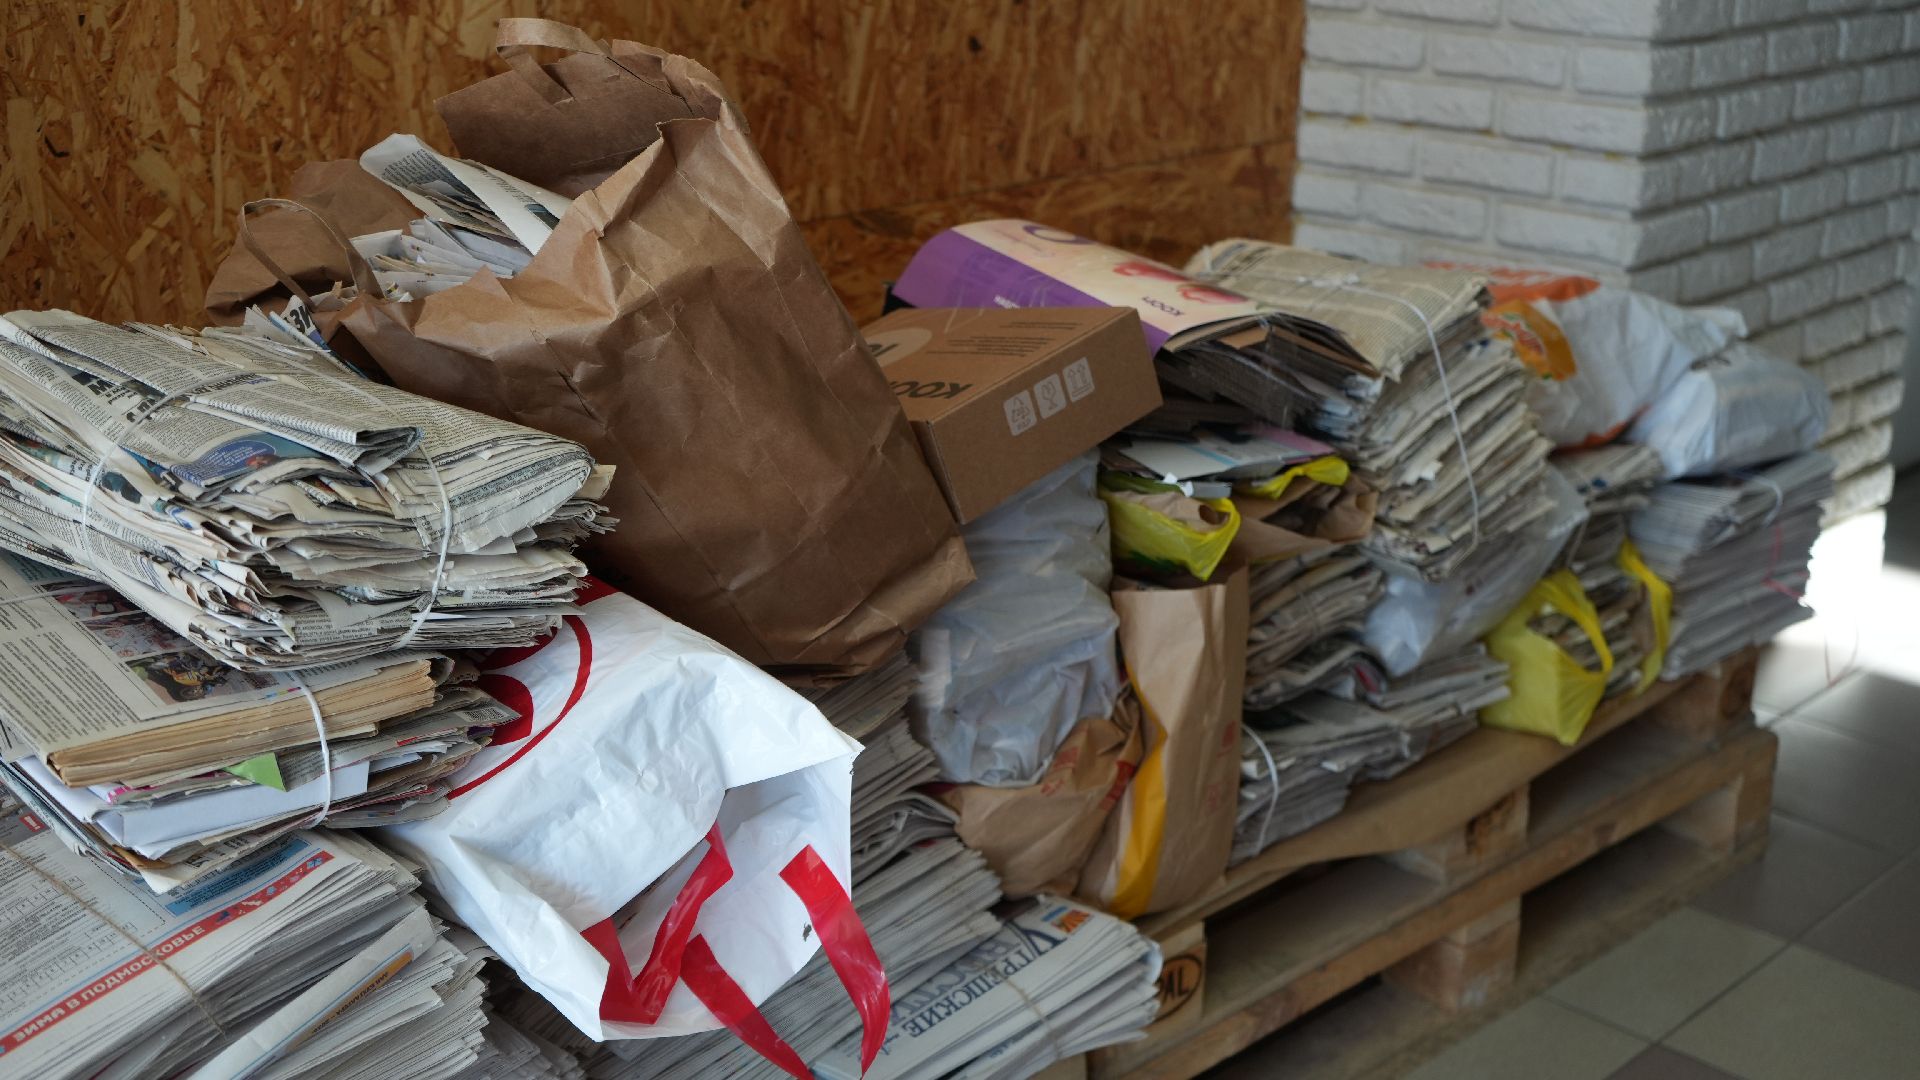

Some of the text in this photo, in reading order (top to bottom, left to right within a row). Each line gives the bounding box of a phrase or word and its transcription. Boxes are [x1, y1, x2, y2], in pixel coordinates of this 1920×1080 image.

[13, 925, 206, 1042] ЗИМА В ПОДМОСКОВЬЕ
[905, 921, 1067, 1038] УГРЕШСКИЕ
